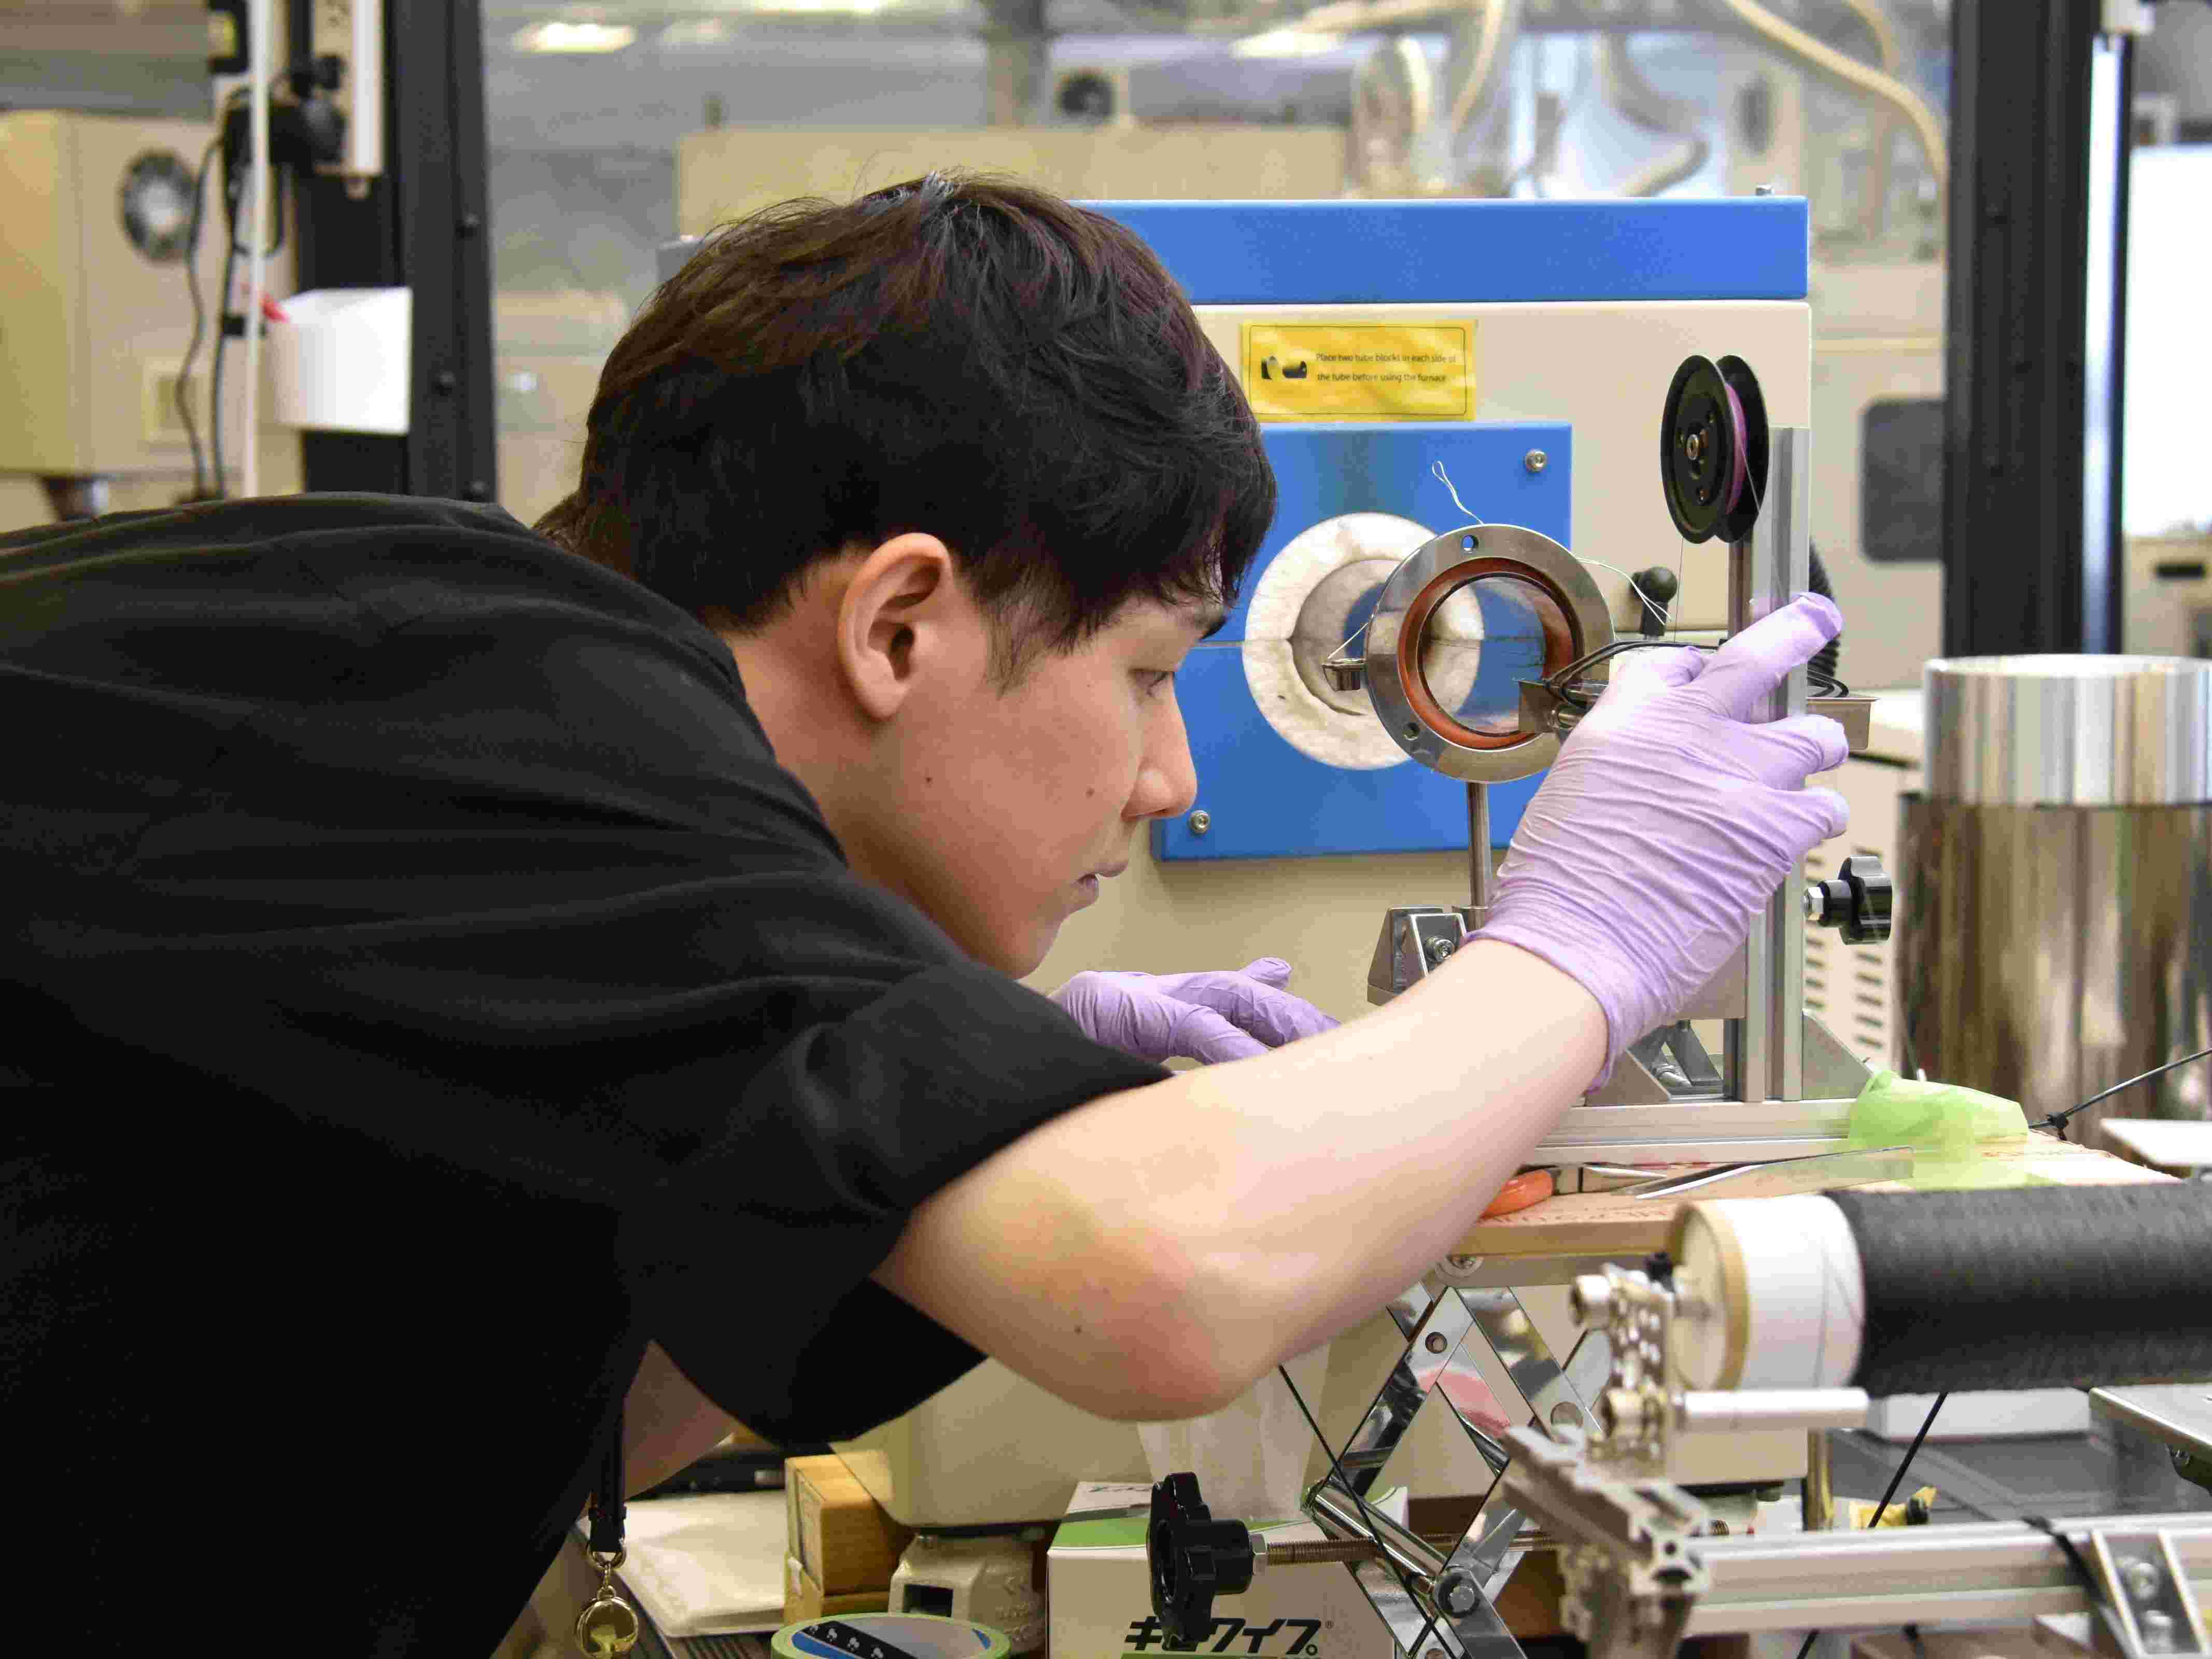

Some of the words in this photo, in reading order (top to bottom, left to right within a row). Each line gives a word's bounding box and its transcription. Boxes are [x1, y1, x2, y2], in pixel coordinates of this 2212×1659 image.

[1376, 353, 1400, 361] blocks
[1412, 353, 1430, 362] each
[1317, 373, 1331, 382] the
[1332, 373, 1349, 382] tube
[1352, 373, 1377, 382] before
[1380, 374, 1402, 384] using
[1125, 1616, 1321, 1655] キワイプ
